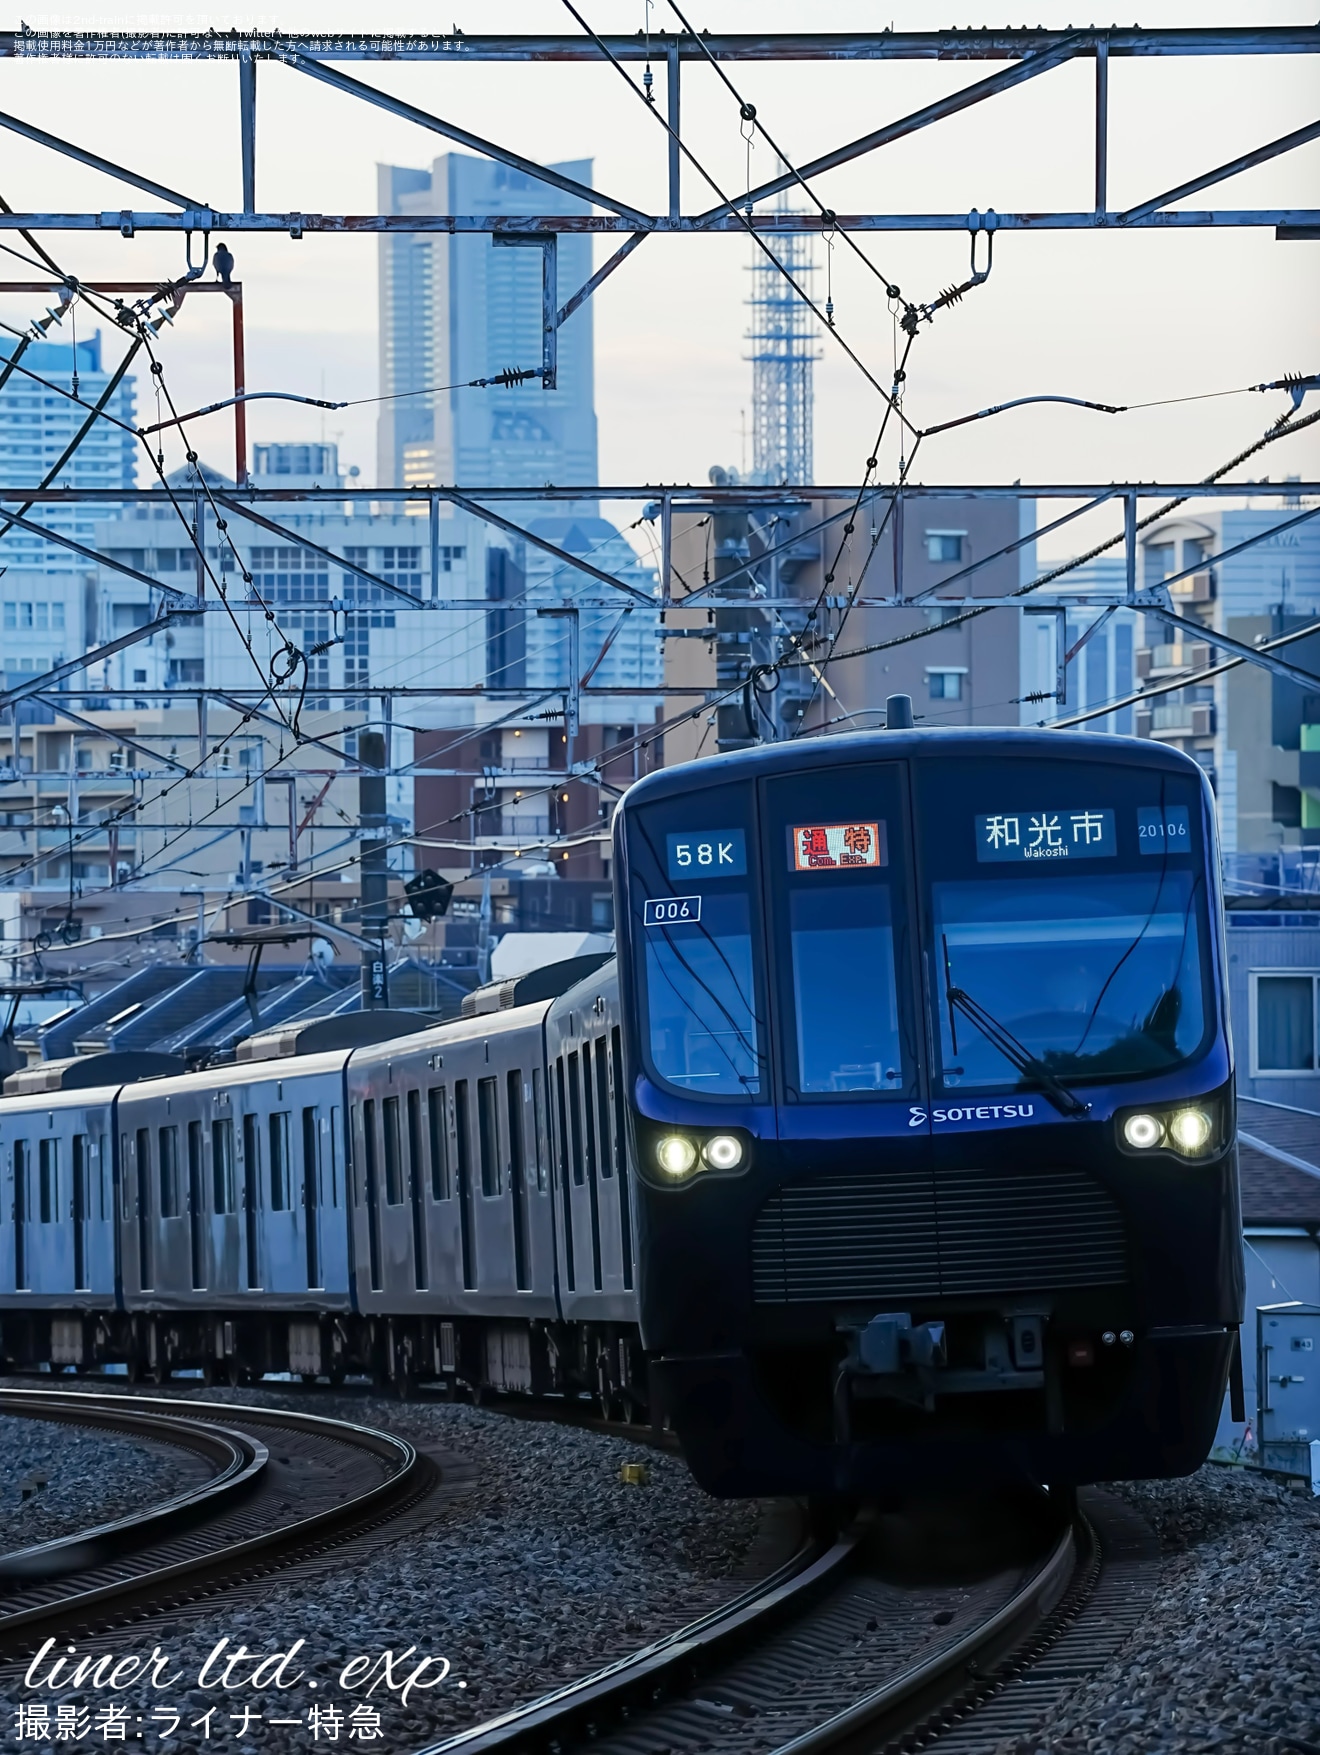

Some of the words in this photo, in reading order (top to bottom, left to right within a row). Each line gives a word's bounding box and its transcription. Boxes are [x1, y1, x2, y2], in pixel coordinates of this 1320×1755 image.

[986, 811, 1104, 849] 和光市
[1139, 823, 1186, 838] 20106
[676, 842, 734, 866] 58K
[1024, 846, 1069, 859] Wakoshi
[654, 902, 690, 920] 006
[932, 1104, 1034, 1122] SOTETSU
